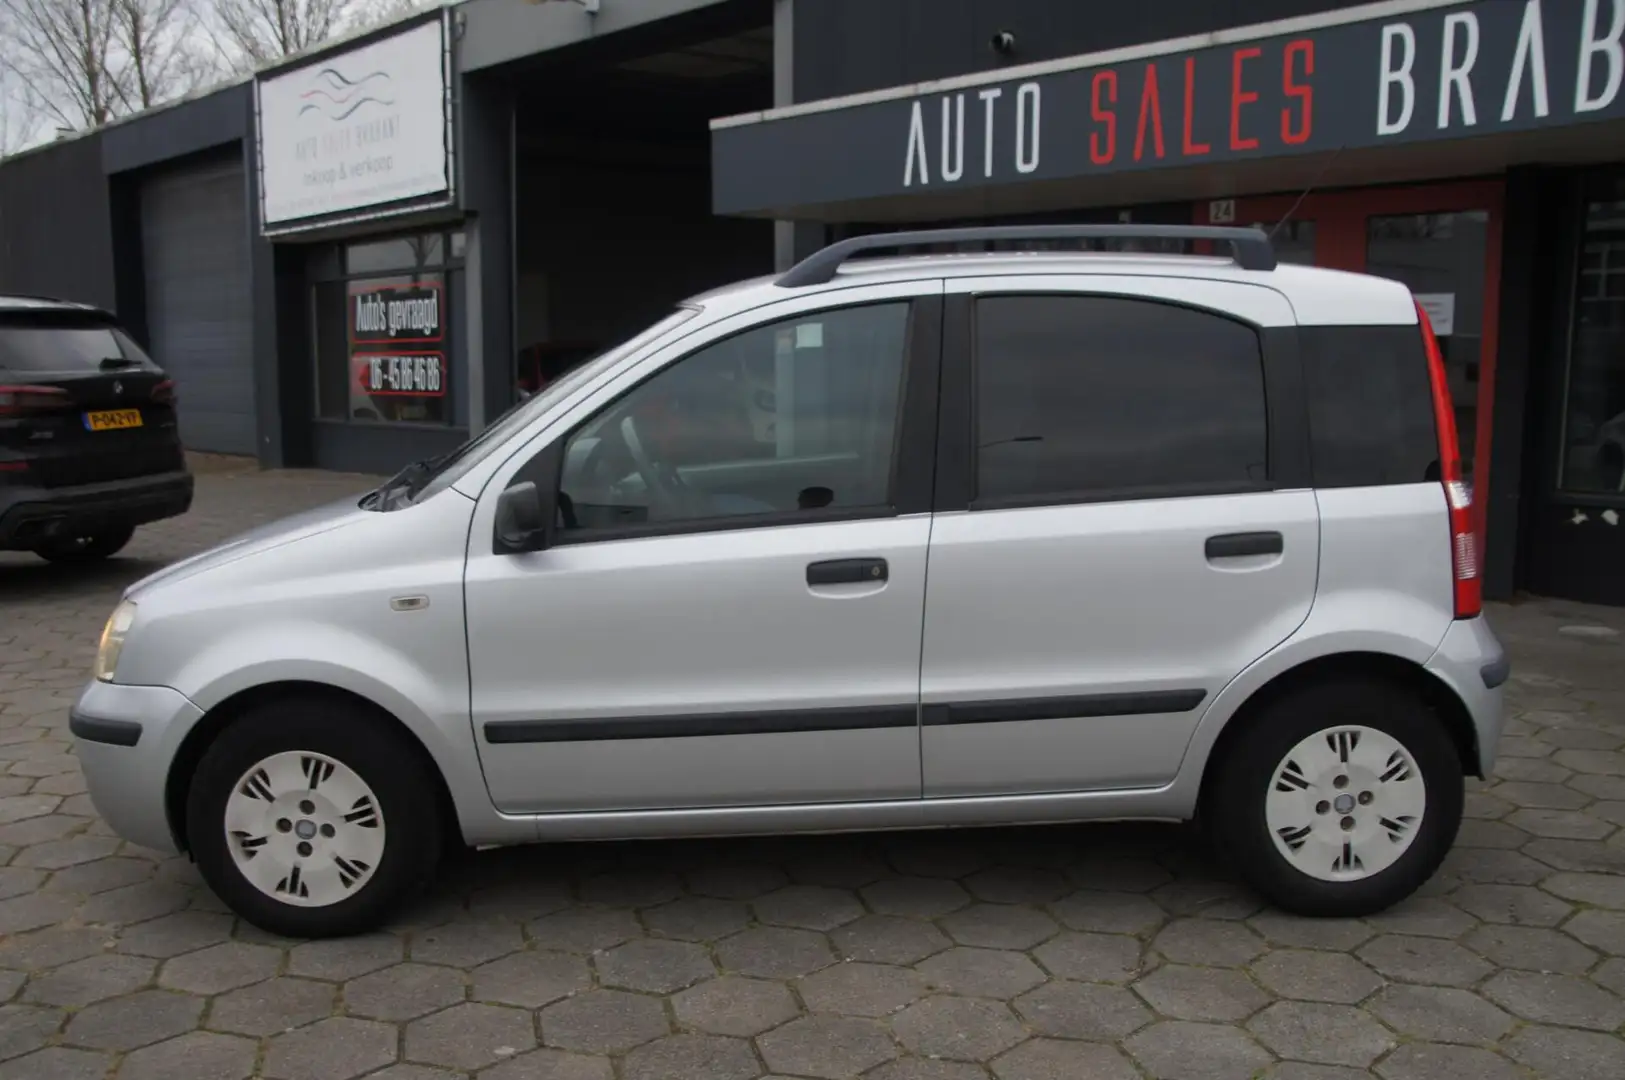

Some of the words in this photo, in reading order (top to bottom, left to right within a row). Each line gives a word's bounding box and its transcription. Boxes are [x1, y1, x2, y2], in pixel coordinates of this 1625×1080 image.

[903, 82, 1041, 187] AUTO
[1089, 39, 1315, 166] SALES
[1376, 0, 1625, 136] BRAB
[1213, 202, 1231, 220] 24
[356, 293, 387, 331] Auto's
[388, 288, 438, 336] gevraagd
